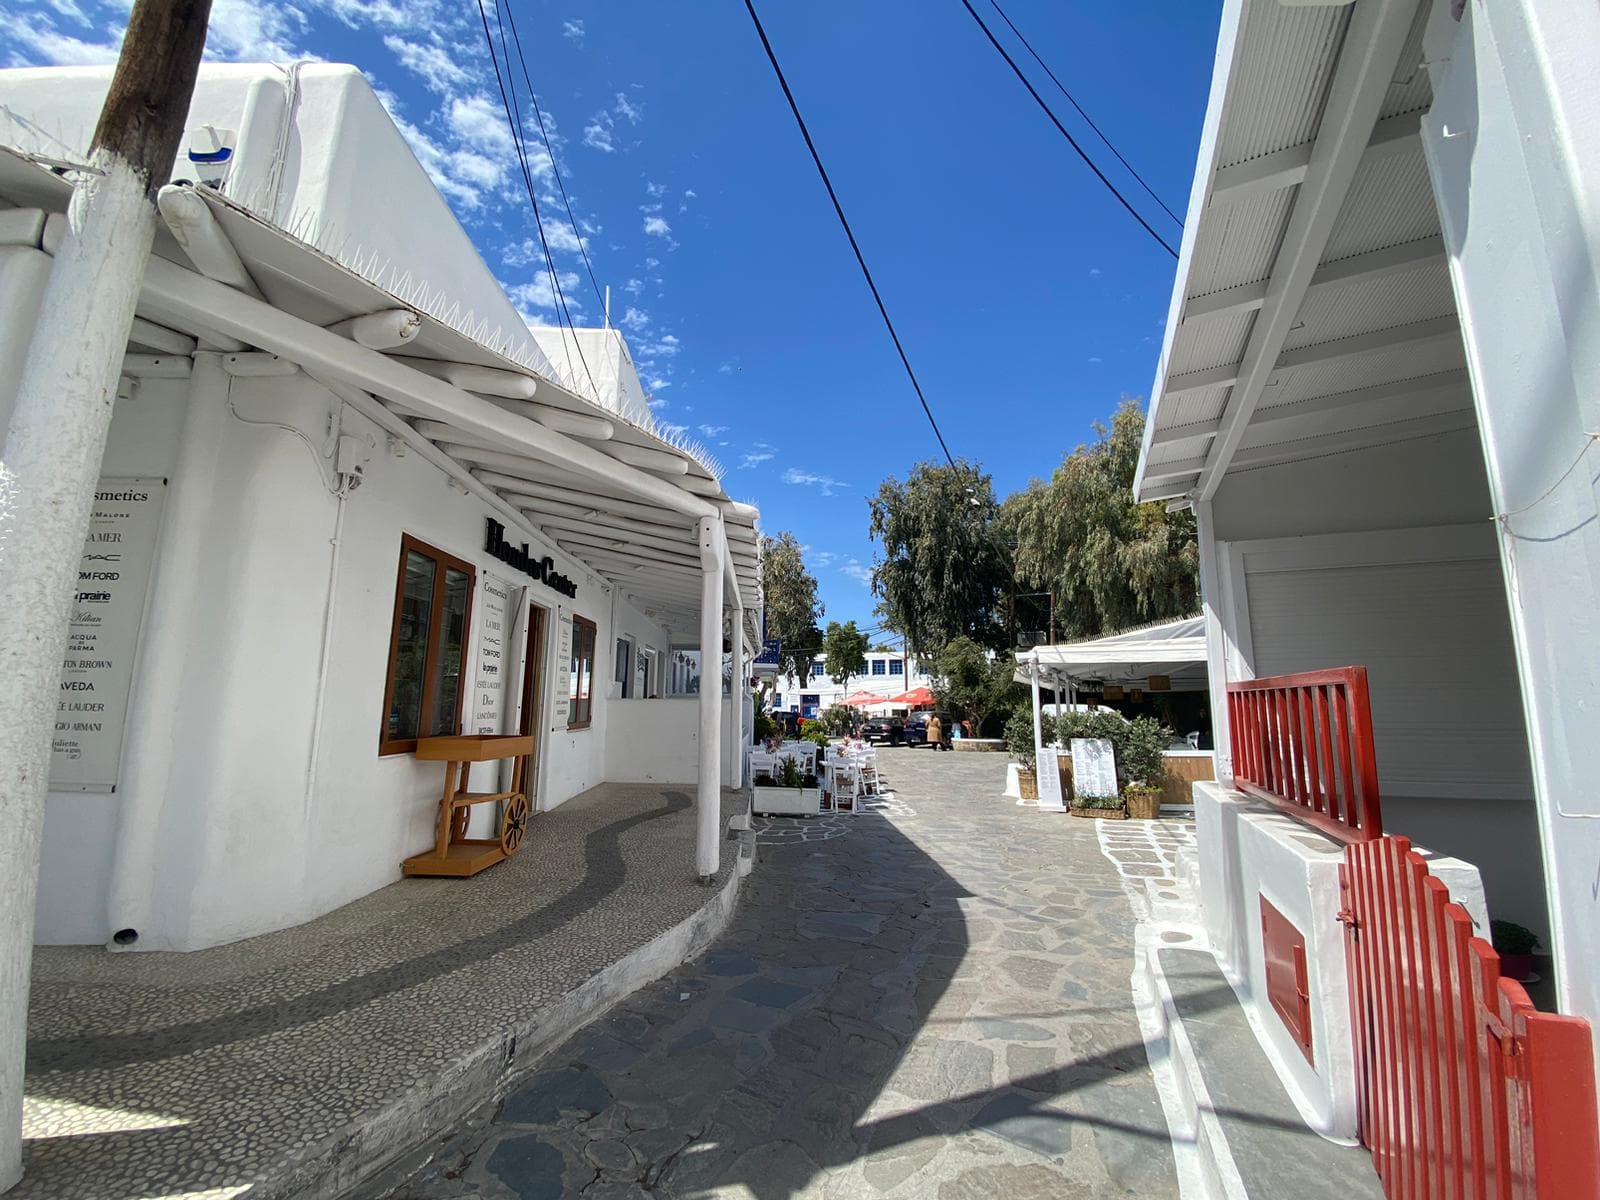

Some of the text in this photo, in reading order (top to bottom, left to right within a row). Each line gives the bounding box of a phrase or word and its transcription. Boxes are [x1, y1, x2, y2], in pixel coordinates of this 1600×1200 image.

[94, 489, 149, 502] smetics
[86, 533, 95, 543] A
[92, 572, 120, 580] FORD
[78, 590, 111, 603] prairie
[63, 660, 113, 669] TON BROWN
[68, 703, 105, 712] LAUDER
[55, 722, 102, 732] GIO ARMANI
